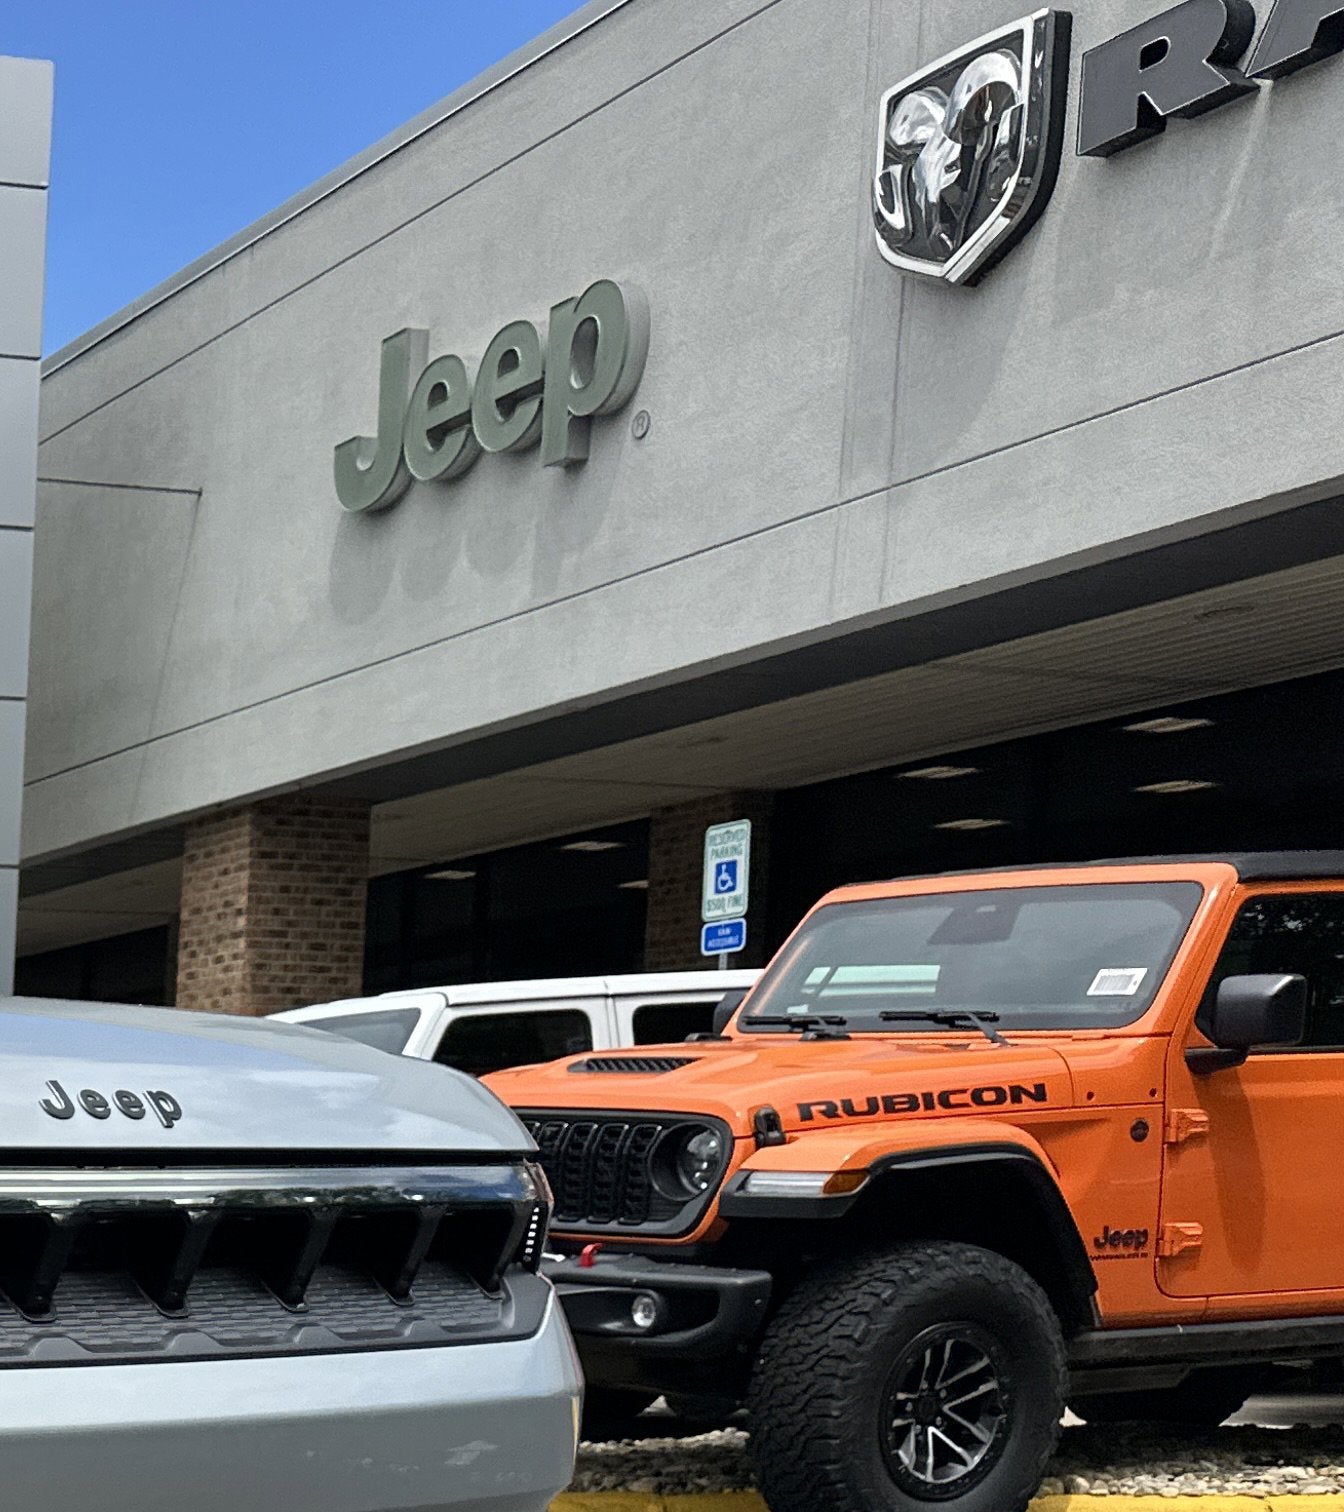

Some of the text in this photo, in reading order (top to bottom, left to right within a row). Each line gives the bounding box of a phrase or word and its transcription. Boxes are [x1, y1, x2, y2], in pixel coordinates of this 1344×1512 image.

[334, 279, 650, 512] Jeep
[38, 1080, 182, 1128] Jeep
[796, 1083, 1047, 1122] RUBICON
[1093, 1225, 1148, 1250] Jeep
